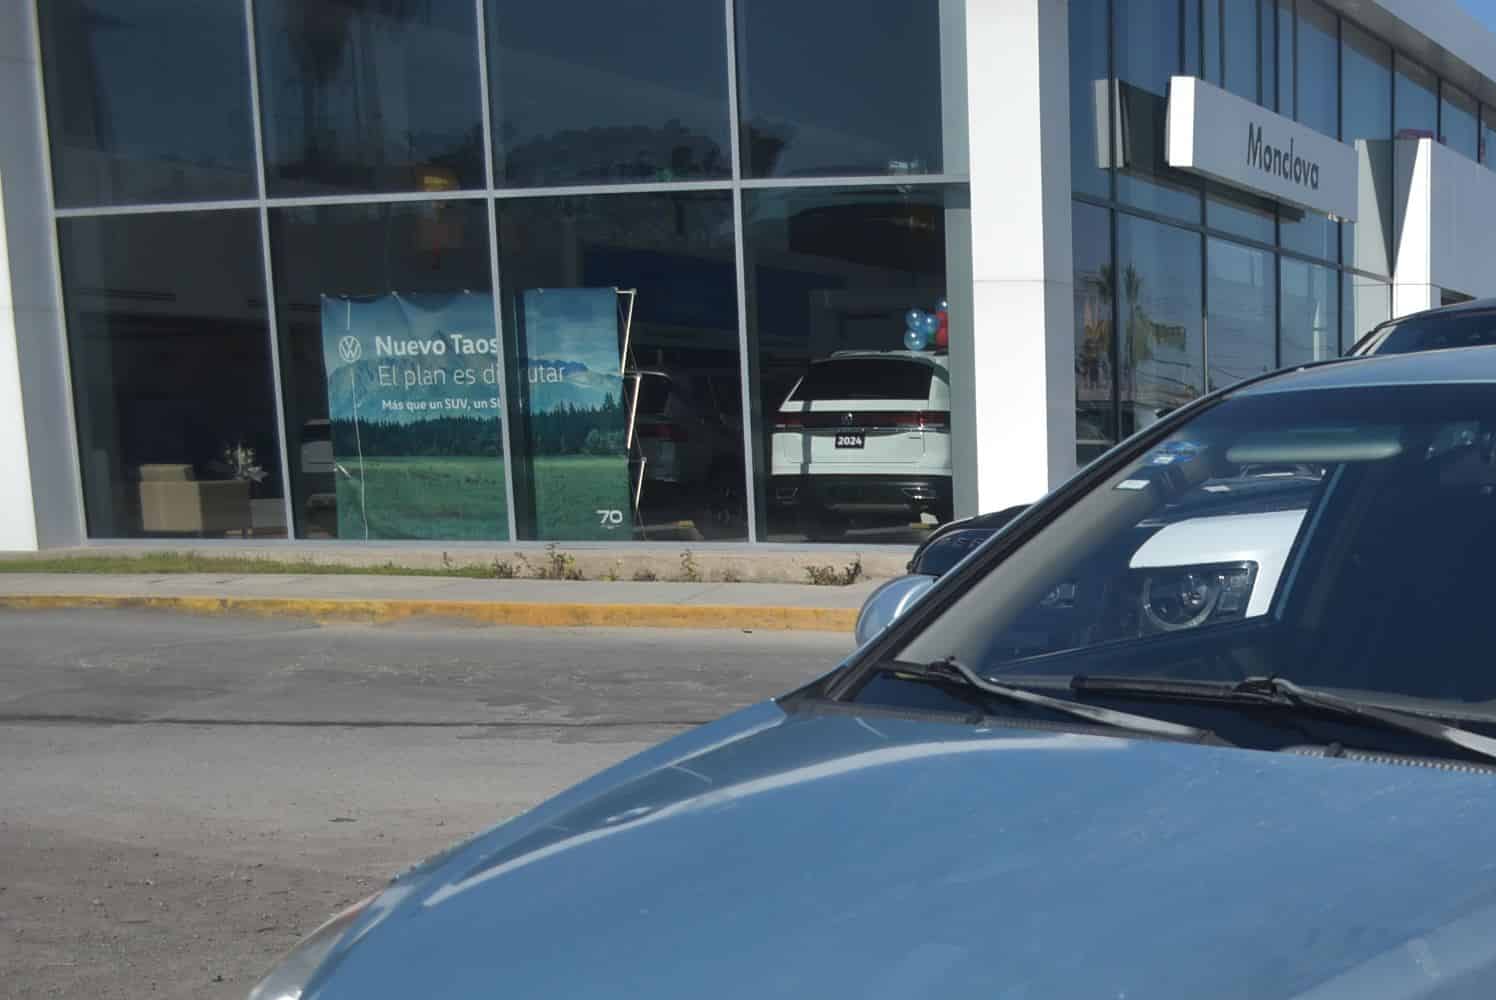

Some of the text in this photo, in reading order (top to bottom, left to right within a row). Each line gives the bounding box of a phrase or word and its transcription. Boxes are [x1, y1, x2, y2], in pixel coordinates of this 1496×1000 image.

[1246, 122, 1320, 190] Monclova
[374, 334, 500, 357] Nuevo Taos
[378, 365, 398, 386] El
[404, 366, 446, 390] plan
[453, 369, 476, 385] es
[382, 399, 403, 410] Más
[406, 400, 426, 412] que
[429, 400, 443, 409] un
[445, 398, 470, 411] SUV,
[474, 400, 488, 409] un
[838, 435, 862, 446] 2024
[596, 509, 623, 524] 70
